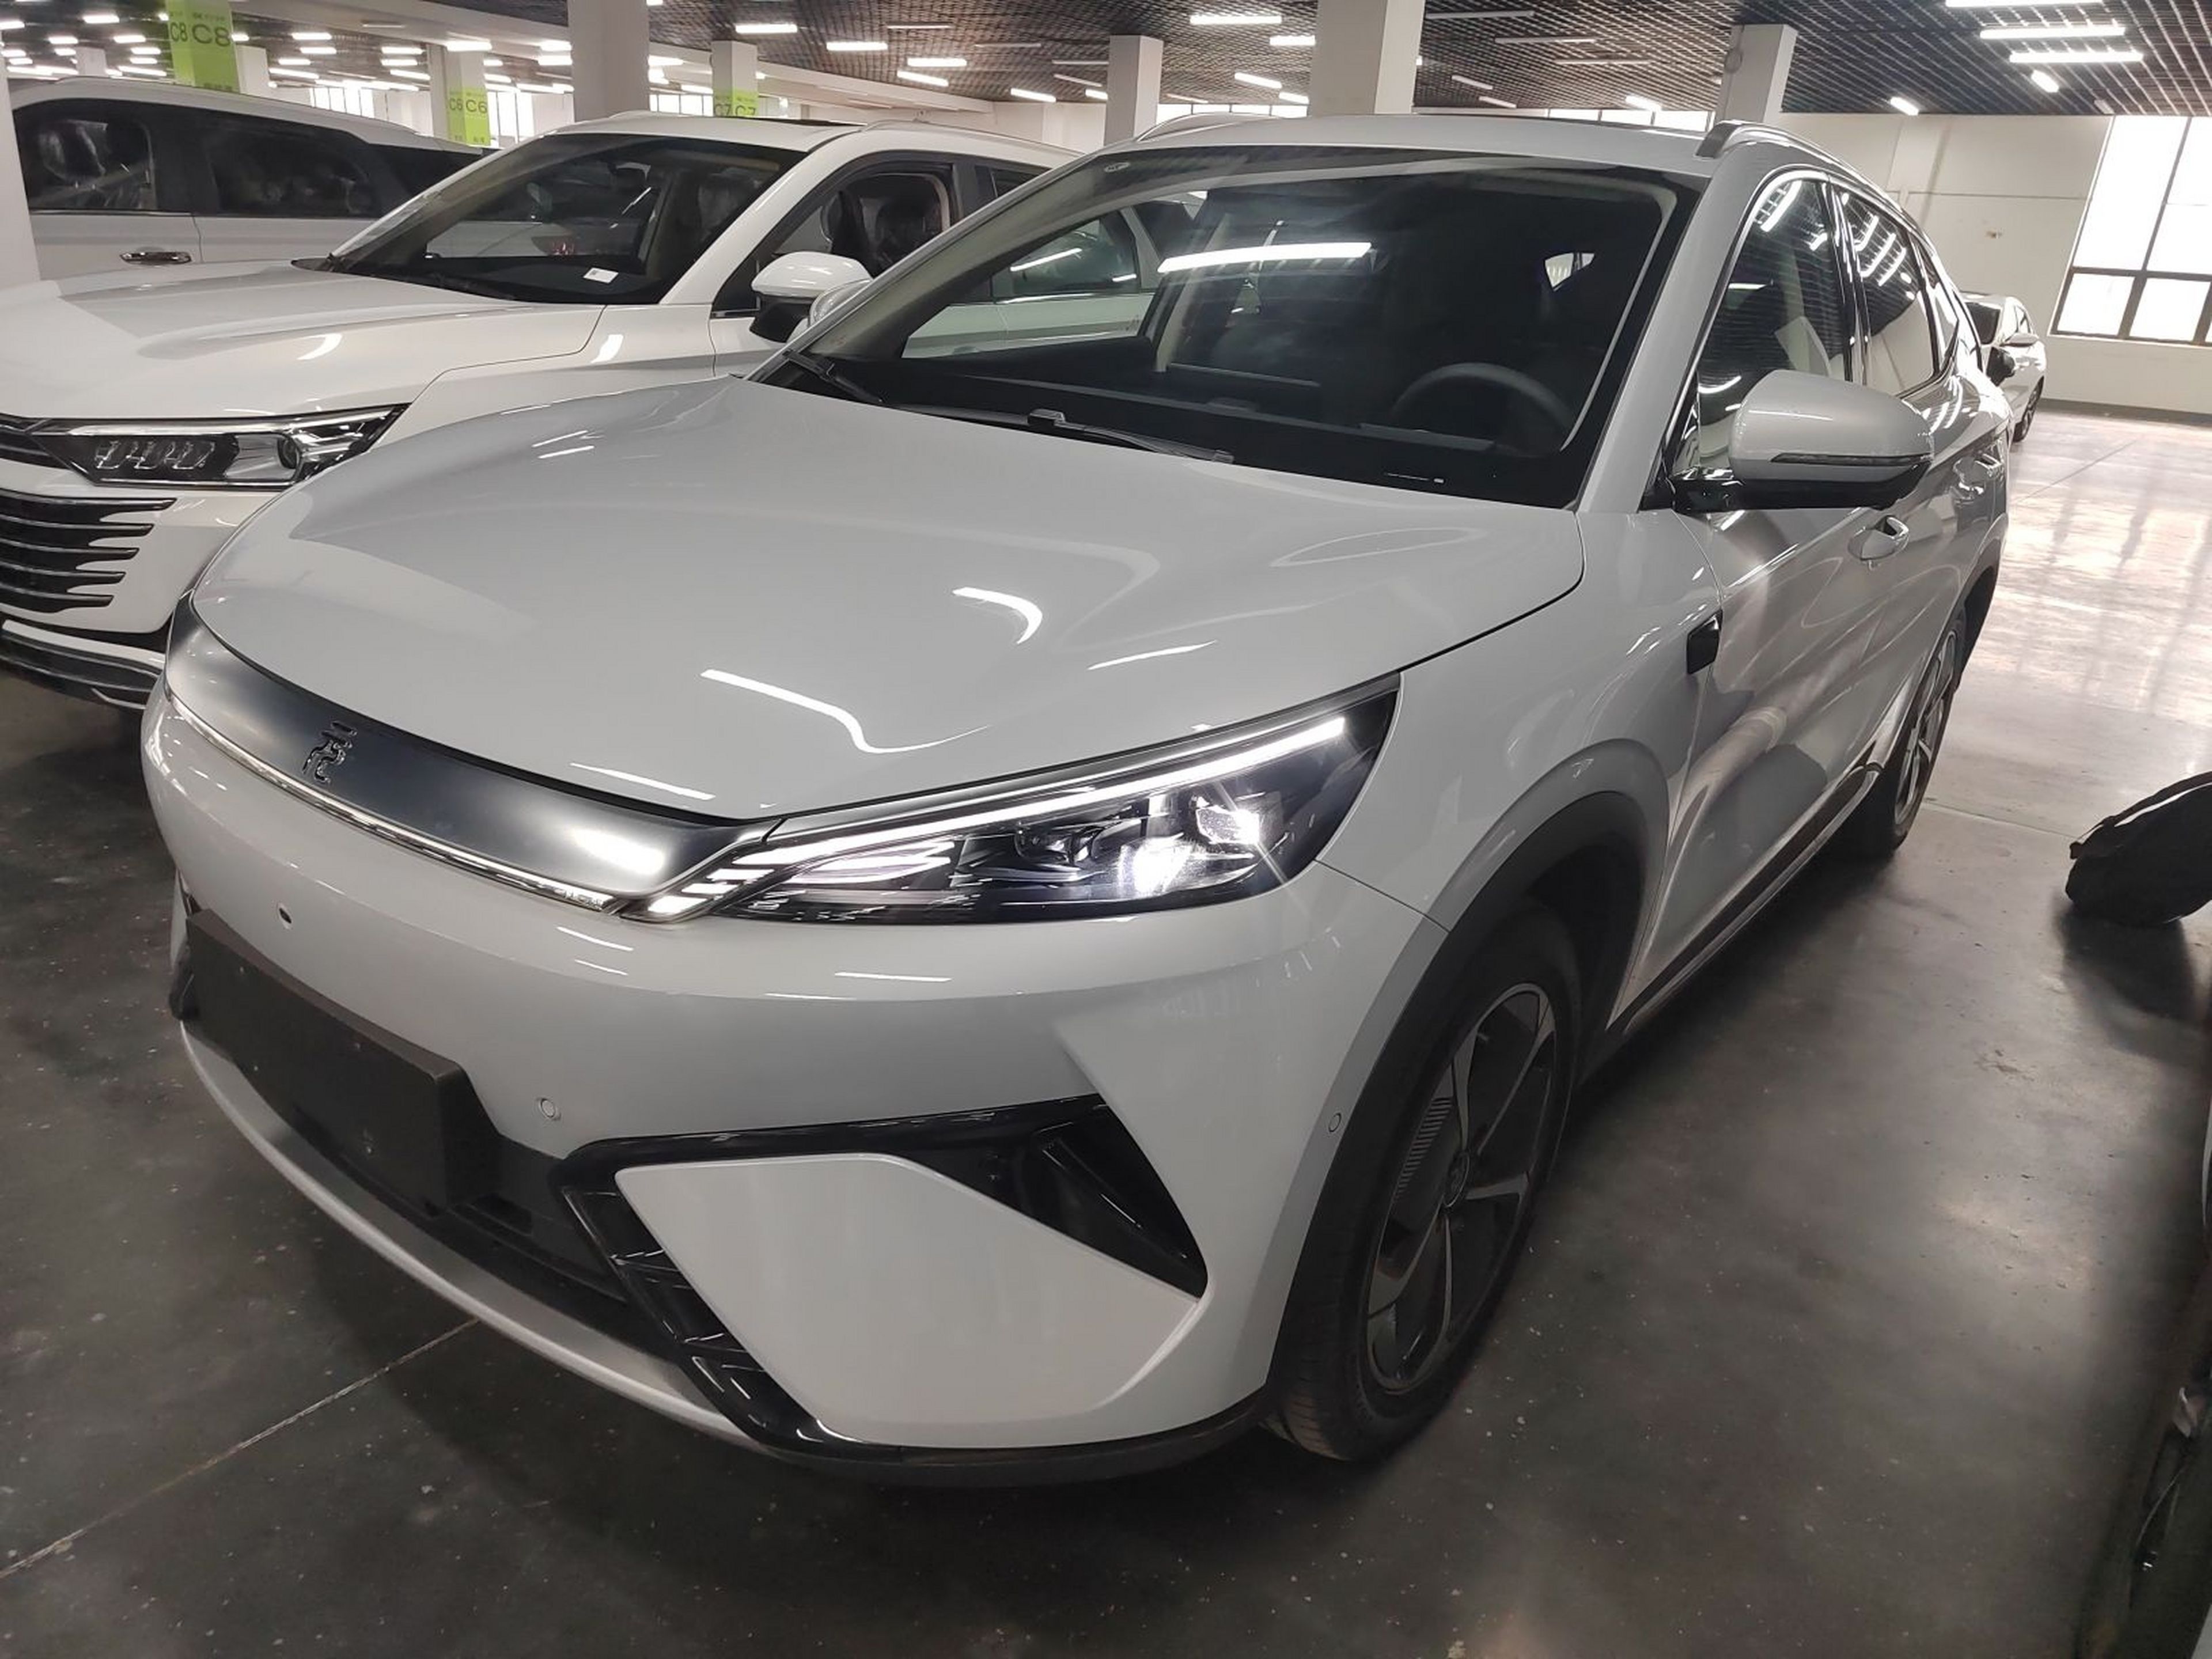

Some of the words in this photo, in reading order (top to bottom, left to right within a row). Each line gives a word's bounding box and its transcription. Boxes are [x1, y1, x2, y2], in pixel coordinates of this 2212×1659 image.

[170, 22, 188, 42] C8
[192, 24, 231, 47] C8
[465, 99, 487, 114] C6
